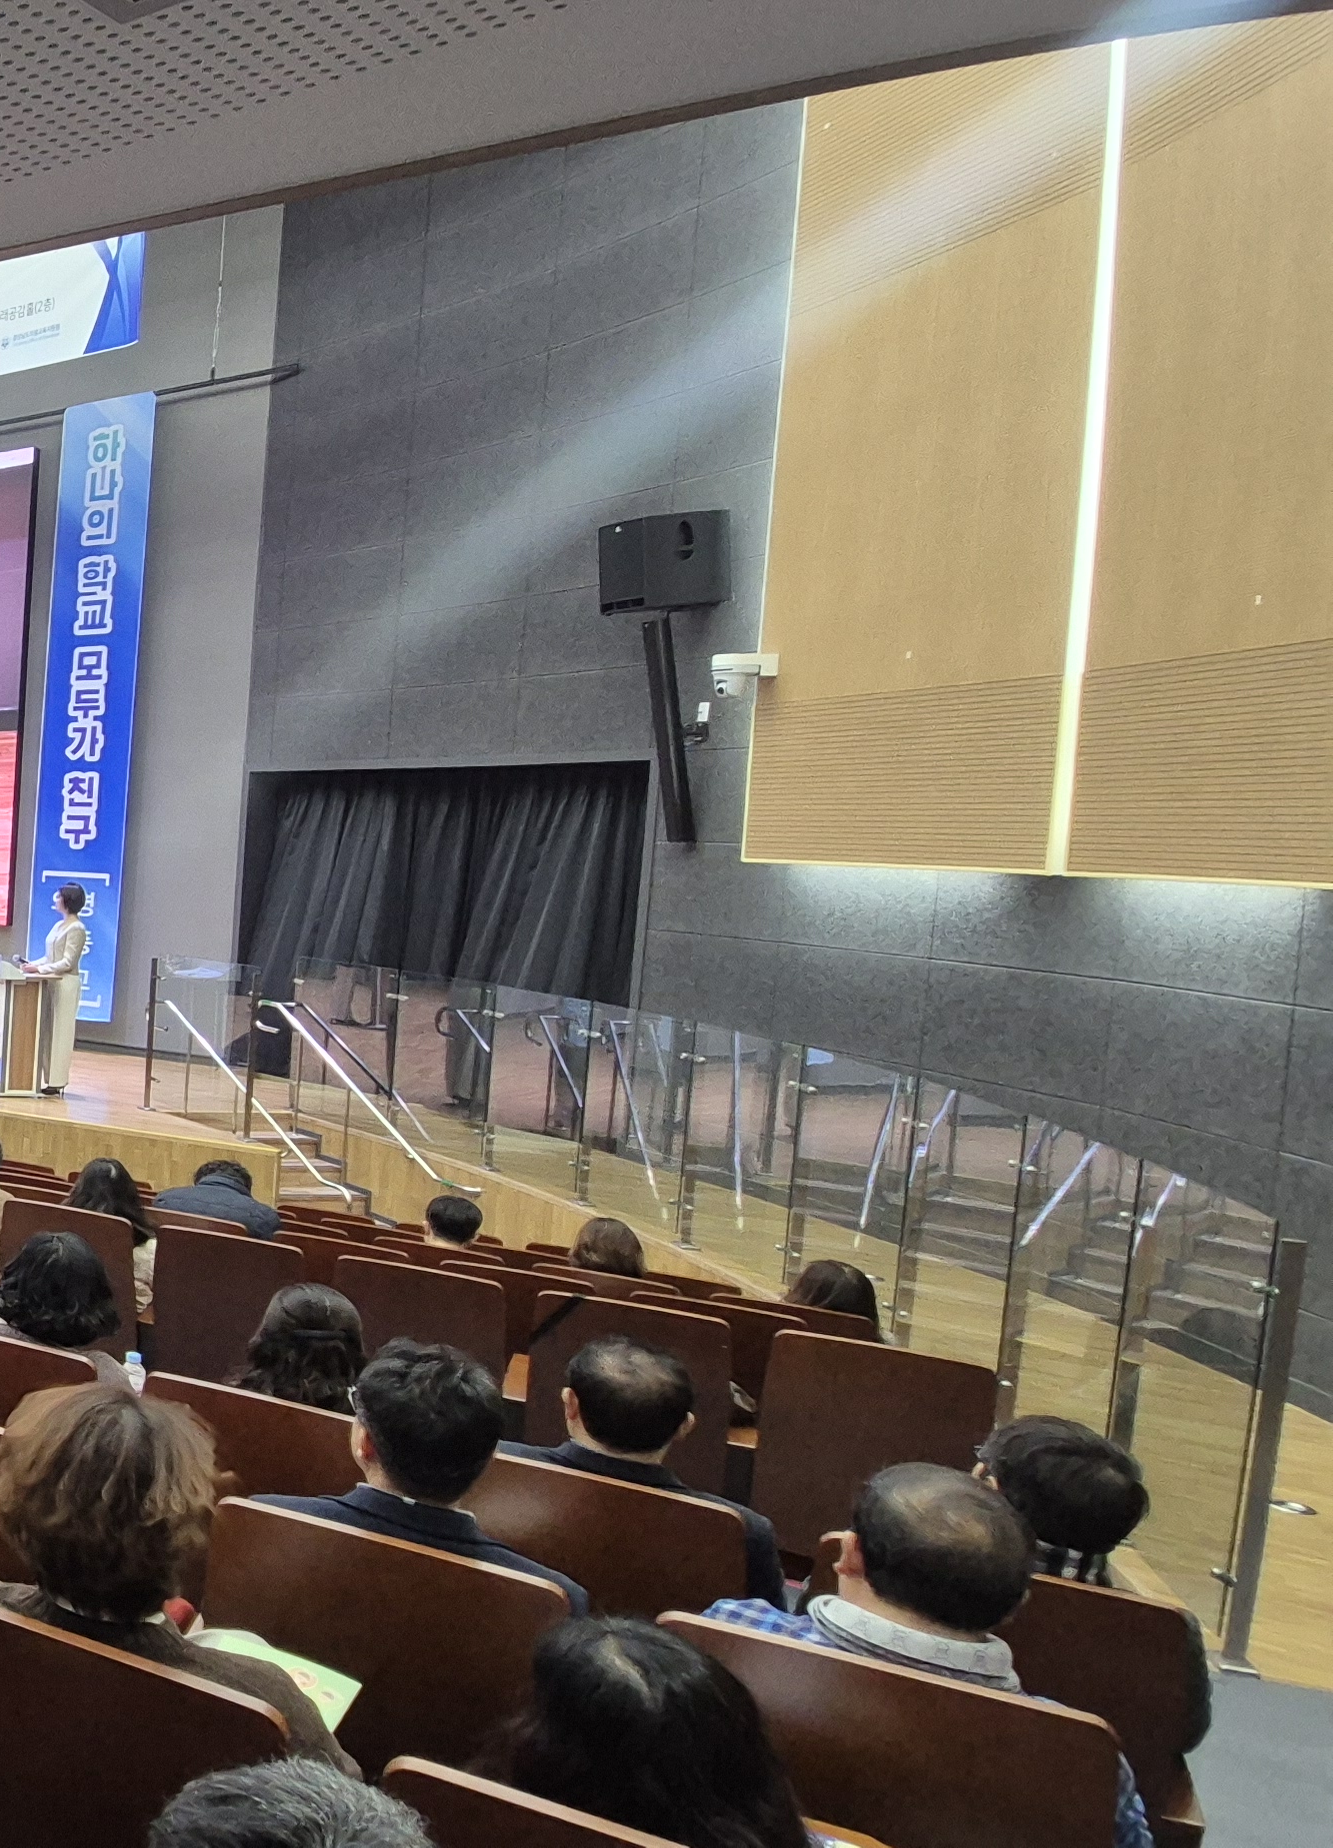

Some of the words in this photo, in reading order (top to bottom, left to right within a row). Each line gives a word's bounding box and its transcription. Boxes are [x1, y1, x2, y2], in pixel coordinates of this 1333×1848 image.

[81, 424, 125, 546] 하나의
[74, 555, 116, 635] 학교
[65, 645, 108, 762] 모두가
[60, 771, 100, 850] 친구
